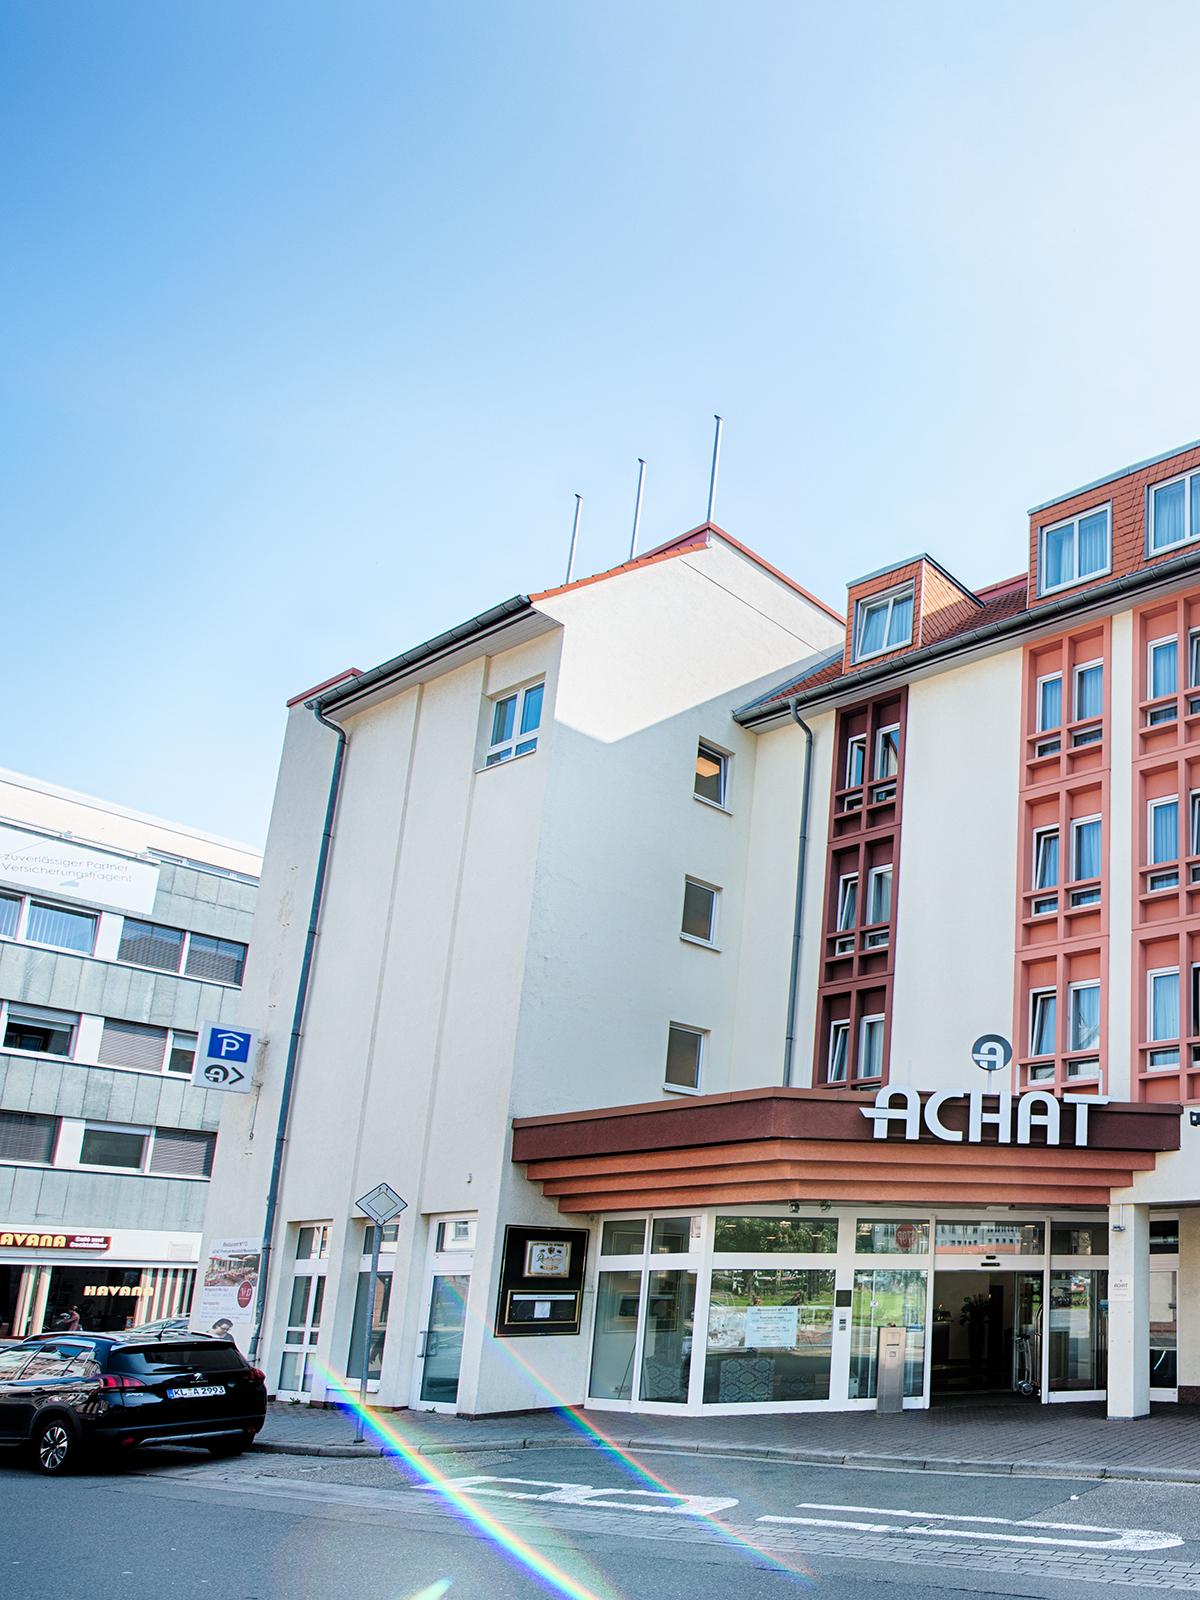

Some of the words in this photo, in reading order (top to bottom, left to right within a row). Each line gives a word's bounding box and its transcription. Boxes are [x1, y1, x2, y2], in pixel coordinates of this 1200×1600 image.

[221, 1038, 240, 1057] P
[859, 1085, 1110, 1147] ACHAT
[83, 1285, 154, 1297] HAVANA
